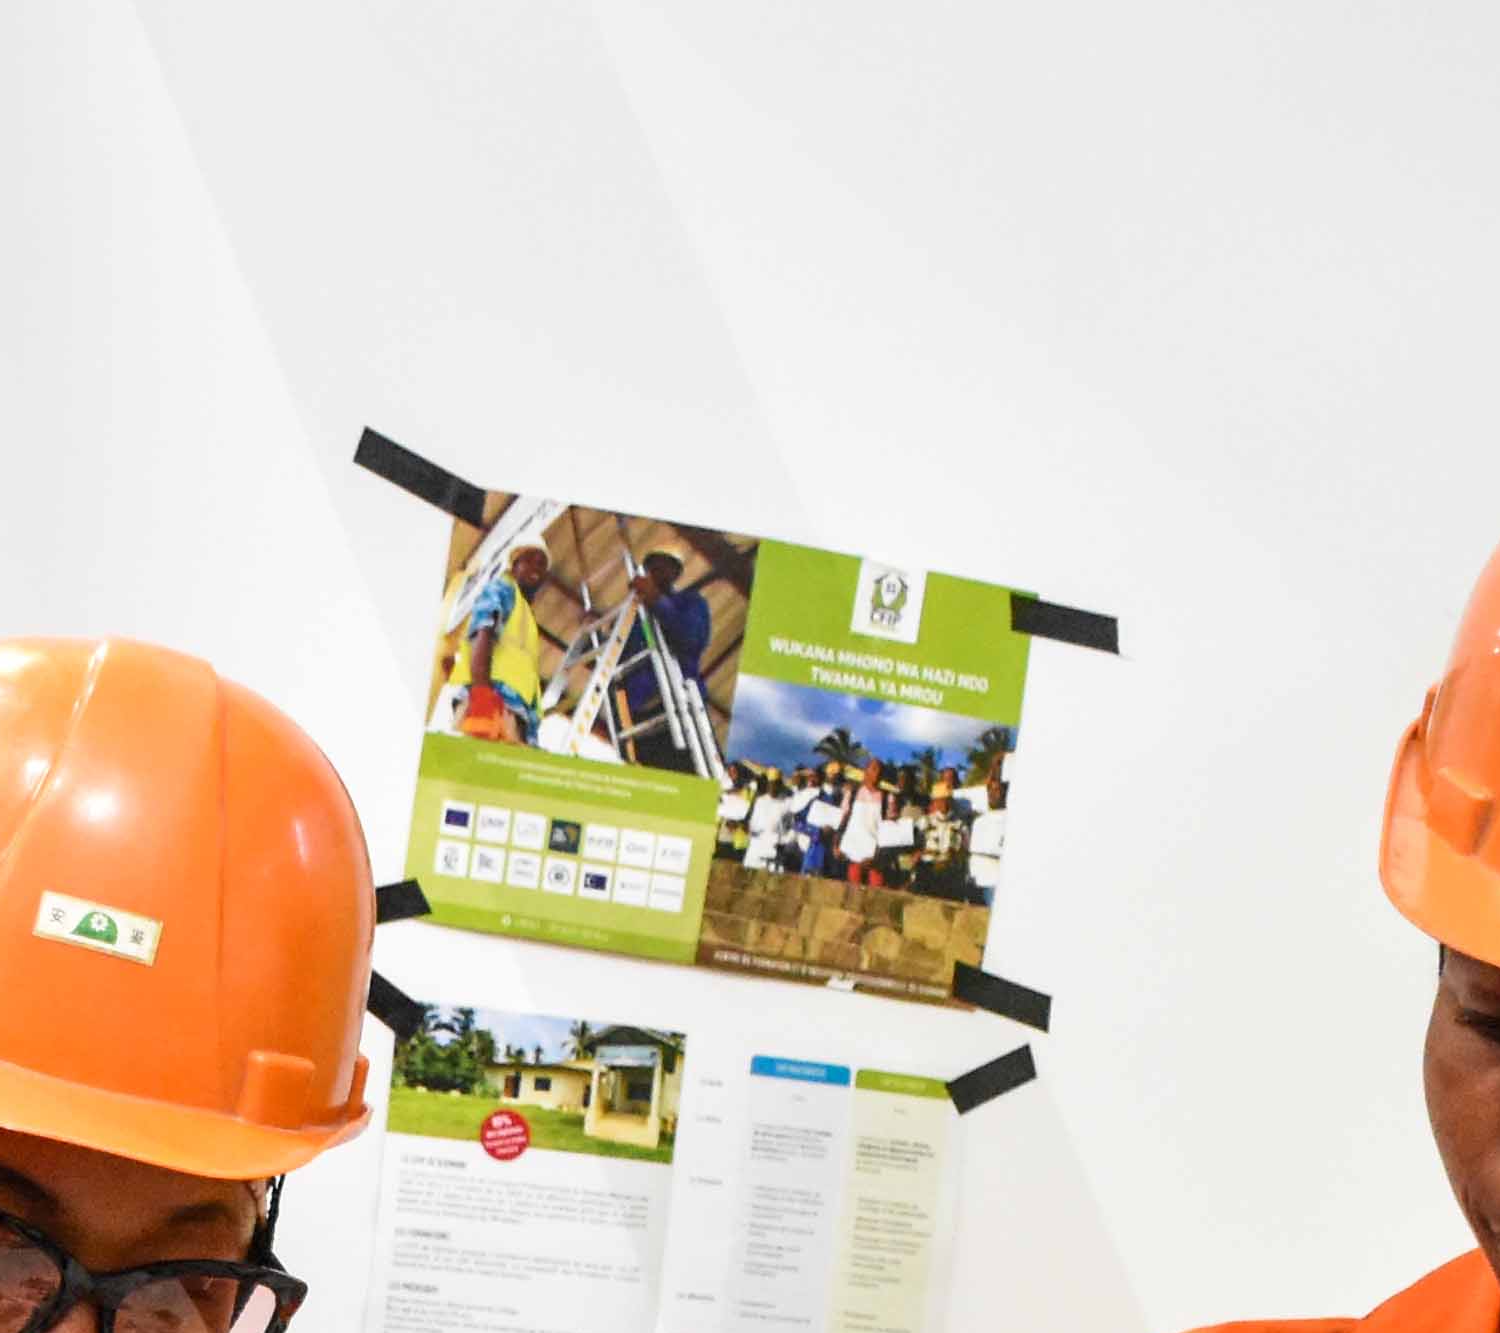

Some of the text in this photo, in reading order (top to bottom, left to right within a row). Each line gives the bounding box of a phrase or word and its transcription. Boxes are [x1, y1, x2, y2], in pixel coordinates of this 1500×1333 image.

[769, 635, 835, 663] WUKANA
[895, 661, 920, 681] WA
[879, 680, 897, 696] YA
